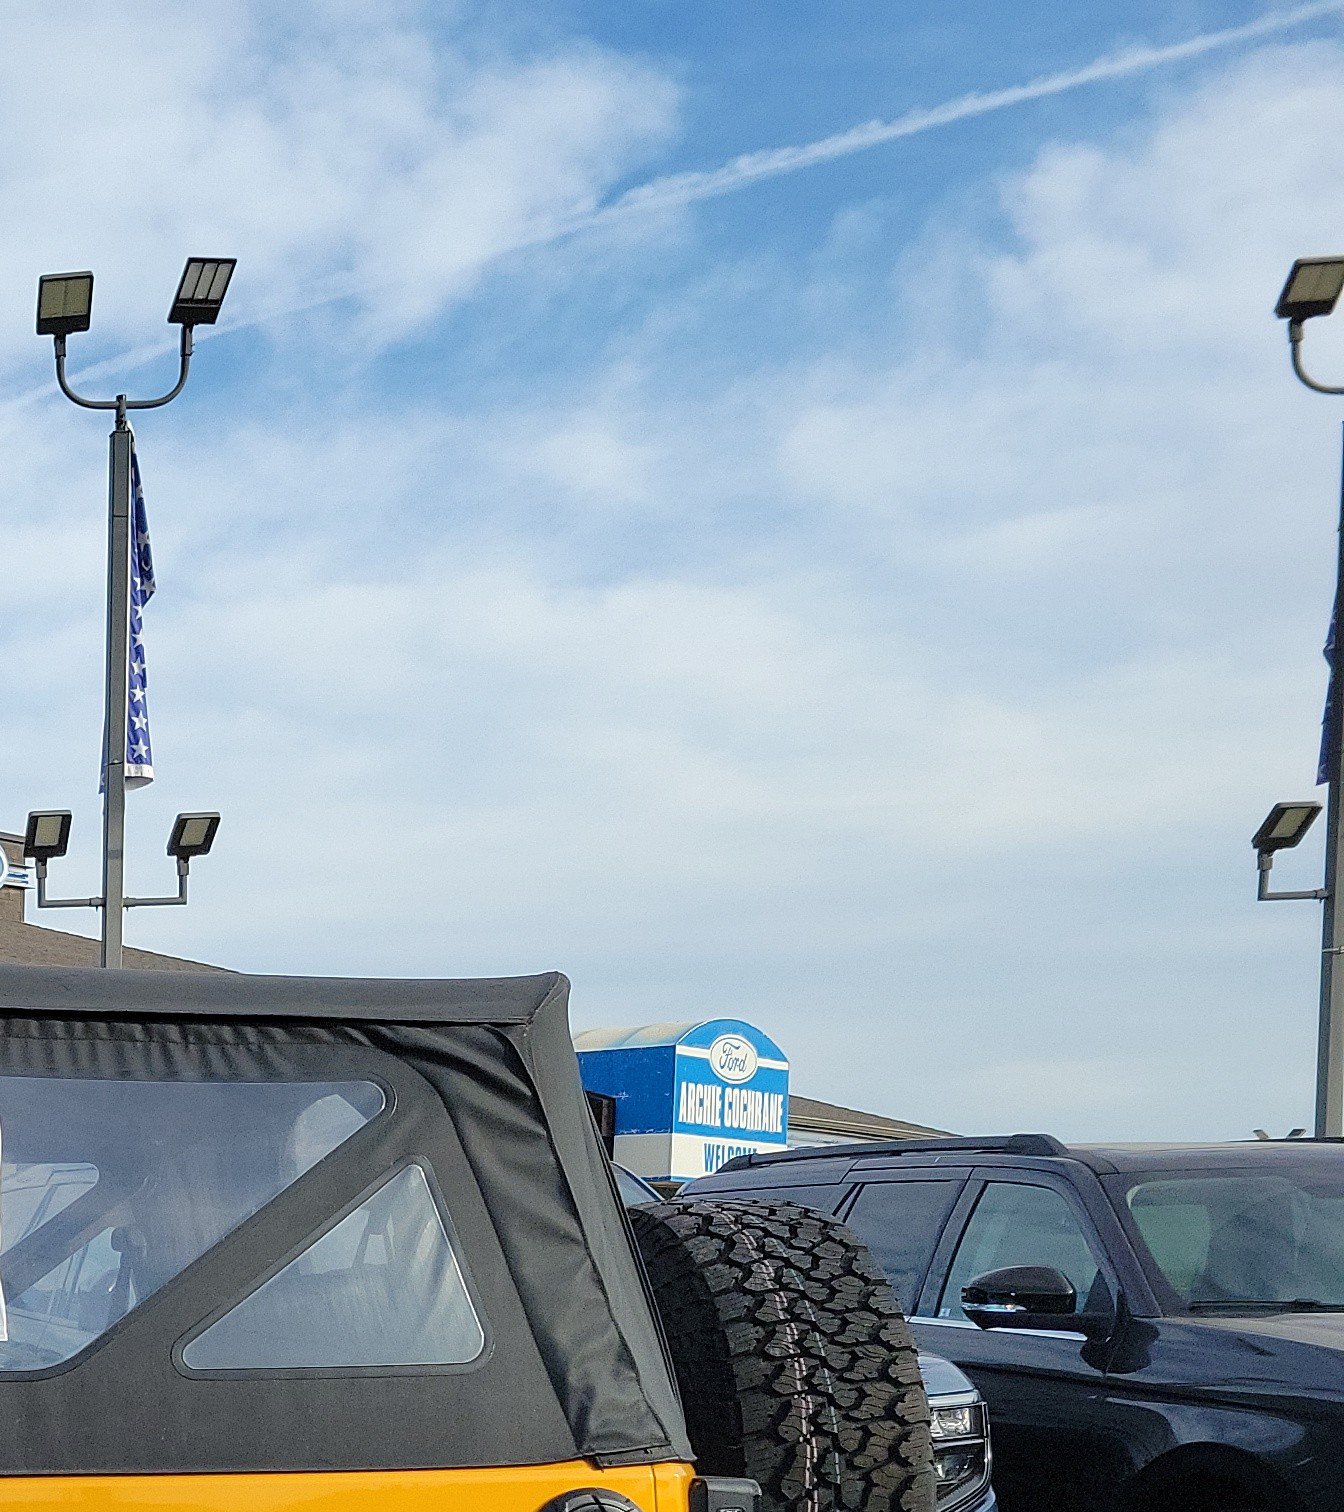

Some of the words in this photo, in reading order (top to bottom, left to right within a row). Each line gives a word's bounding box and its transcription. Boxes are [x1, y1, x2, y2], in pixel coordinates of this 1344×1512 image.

[719, 1041, 748, 1073] Ford
[678, 1081, 722, 1127] ARCHIE
[724, 1087, 784, 1133] COCHRANE
